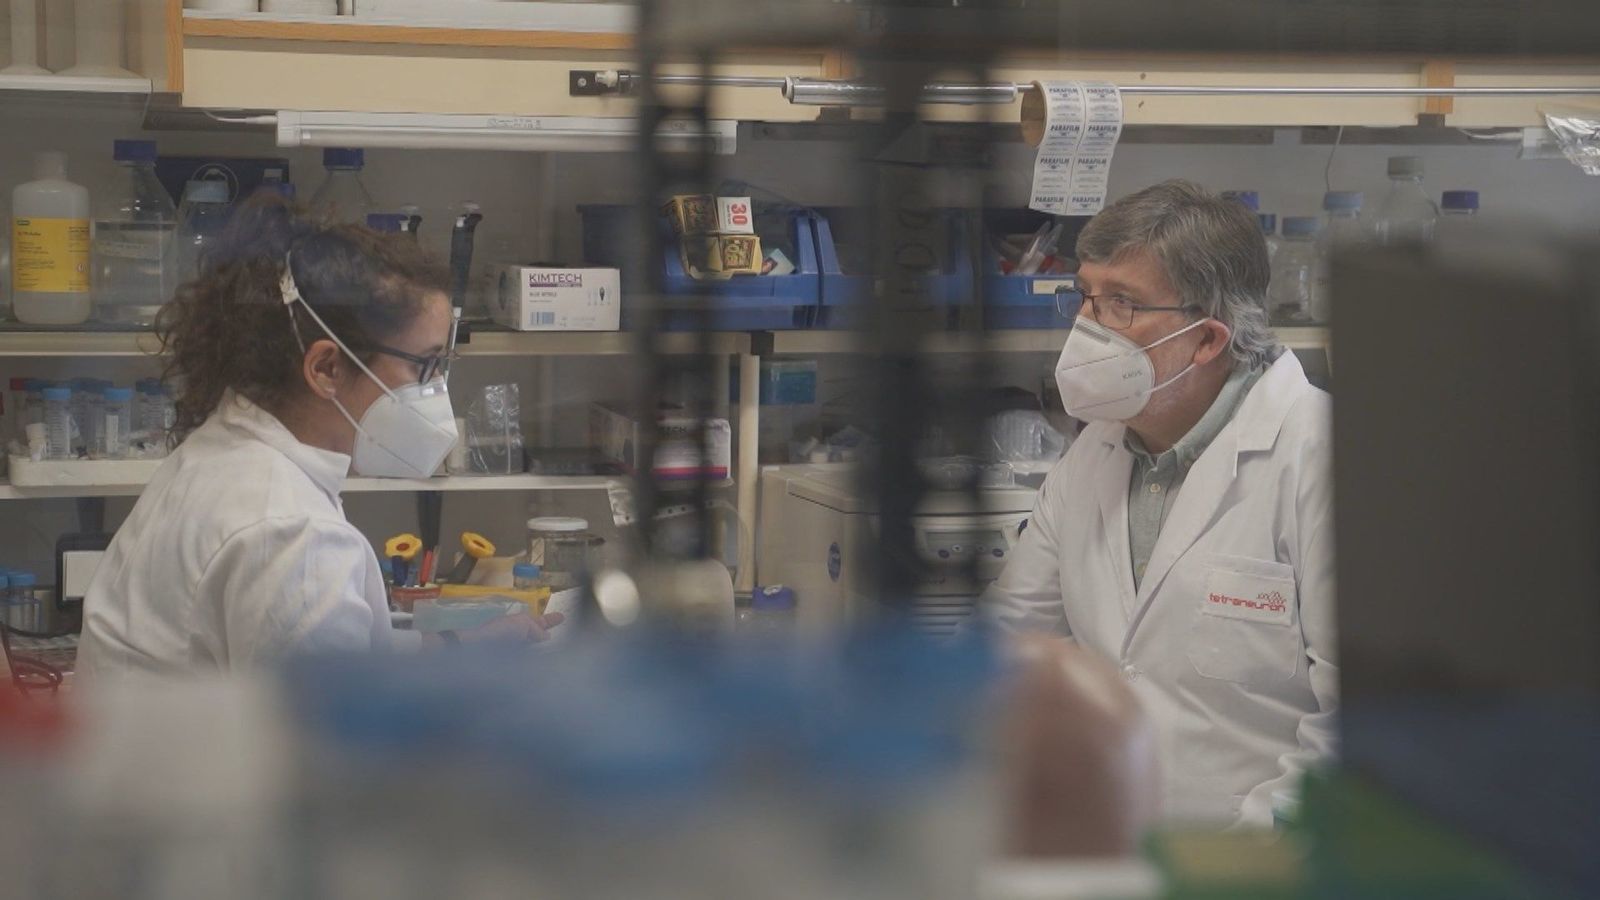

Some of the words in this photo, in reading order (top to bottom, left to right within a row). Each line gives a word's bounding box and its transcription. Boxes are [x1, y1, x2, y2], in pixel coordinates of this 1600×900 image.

[1050, 125, 1080, 133] PARAFILM
[1088, 125, 1118, 133] PARAFILM
[1040, 158, 1070, 166] PARAFILM
[1078, 158, 1107, 166] PARAFILM
[1035, 196, 1064, 204] PARAFILM
[1072, 196, 1101, 204] PARAFILM
[731, 203, 748, 225] 30
[529, 272, 583, 284] KIMTECH
[1209, 592, 1287, 613] tetraneuron
